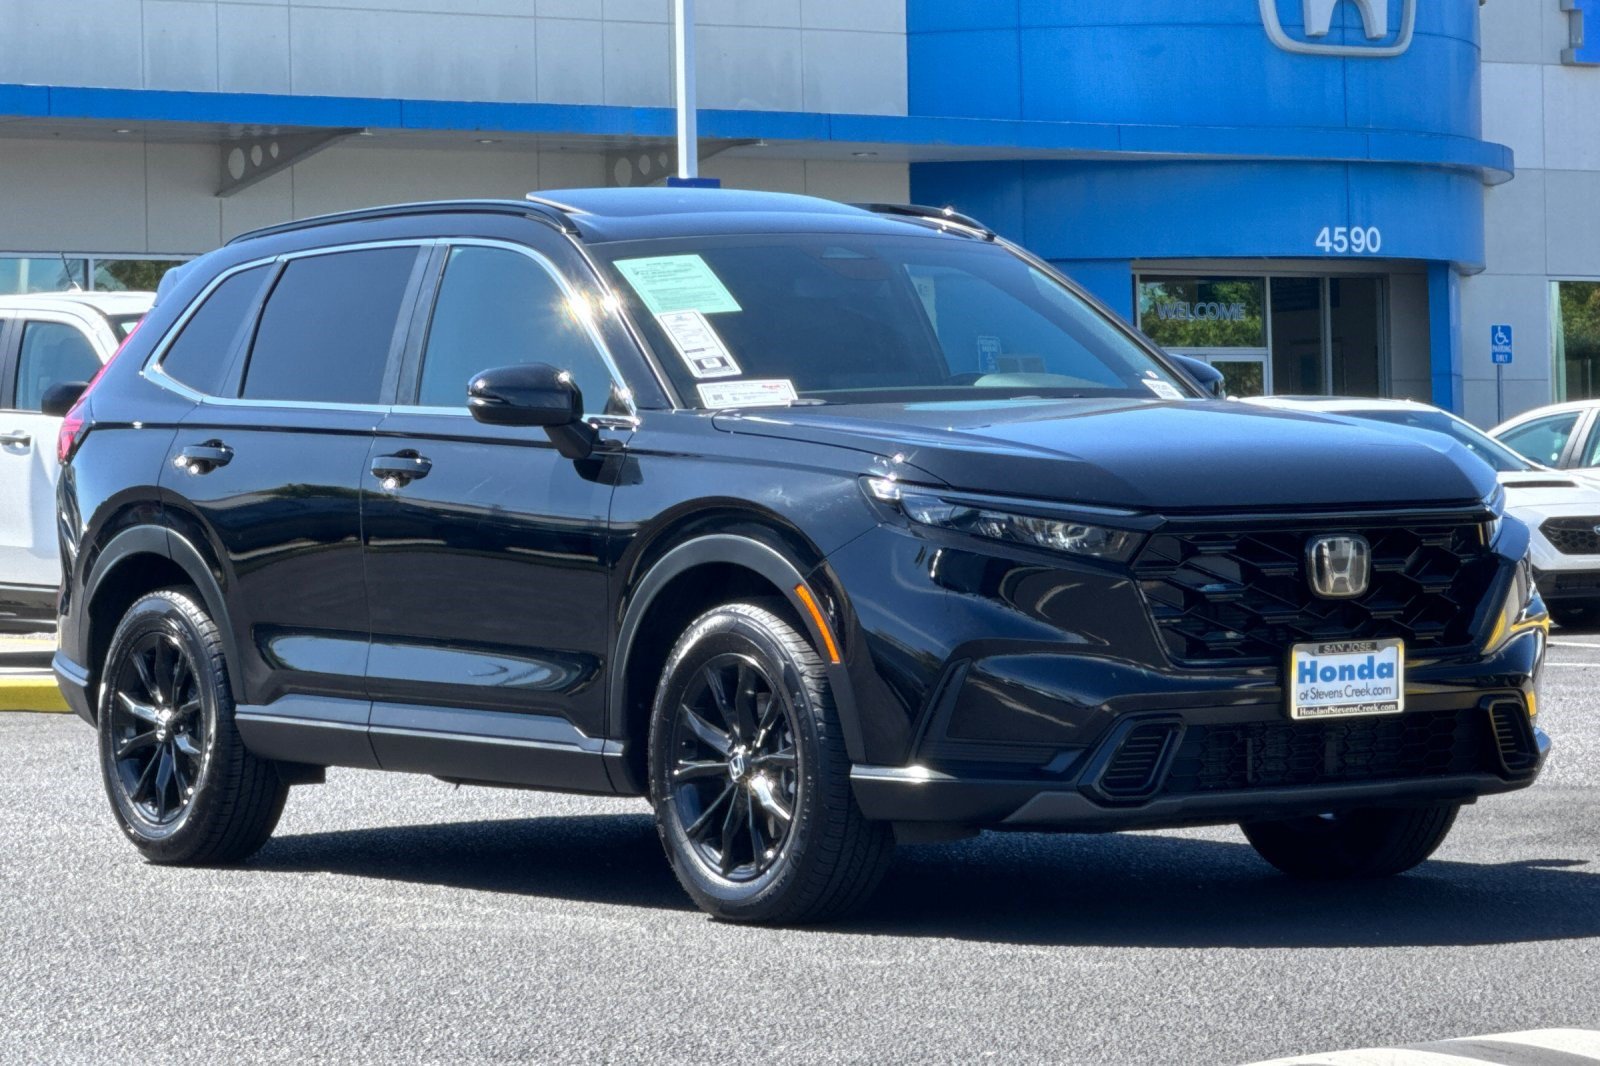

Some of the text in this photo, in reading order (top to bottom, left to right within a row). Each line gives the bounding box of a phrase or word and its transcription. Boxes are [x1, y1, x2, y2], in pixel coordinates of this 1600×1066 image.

[1315, 226, 1382, 253] 4590
[1156, 301, 1246, 321] WELCOME
[1495, 354, 1508, 362] ONLY
[1323, 642, 1372, 653] SAN JOSE
[1298, 656, 1394, 684] Honda
[1299, 682, 1392, 701] of Stevens Creek.com
